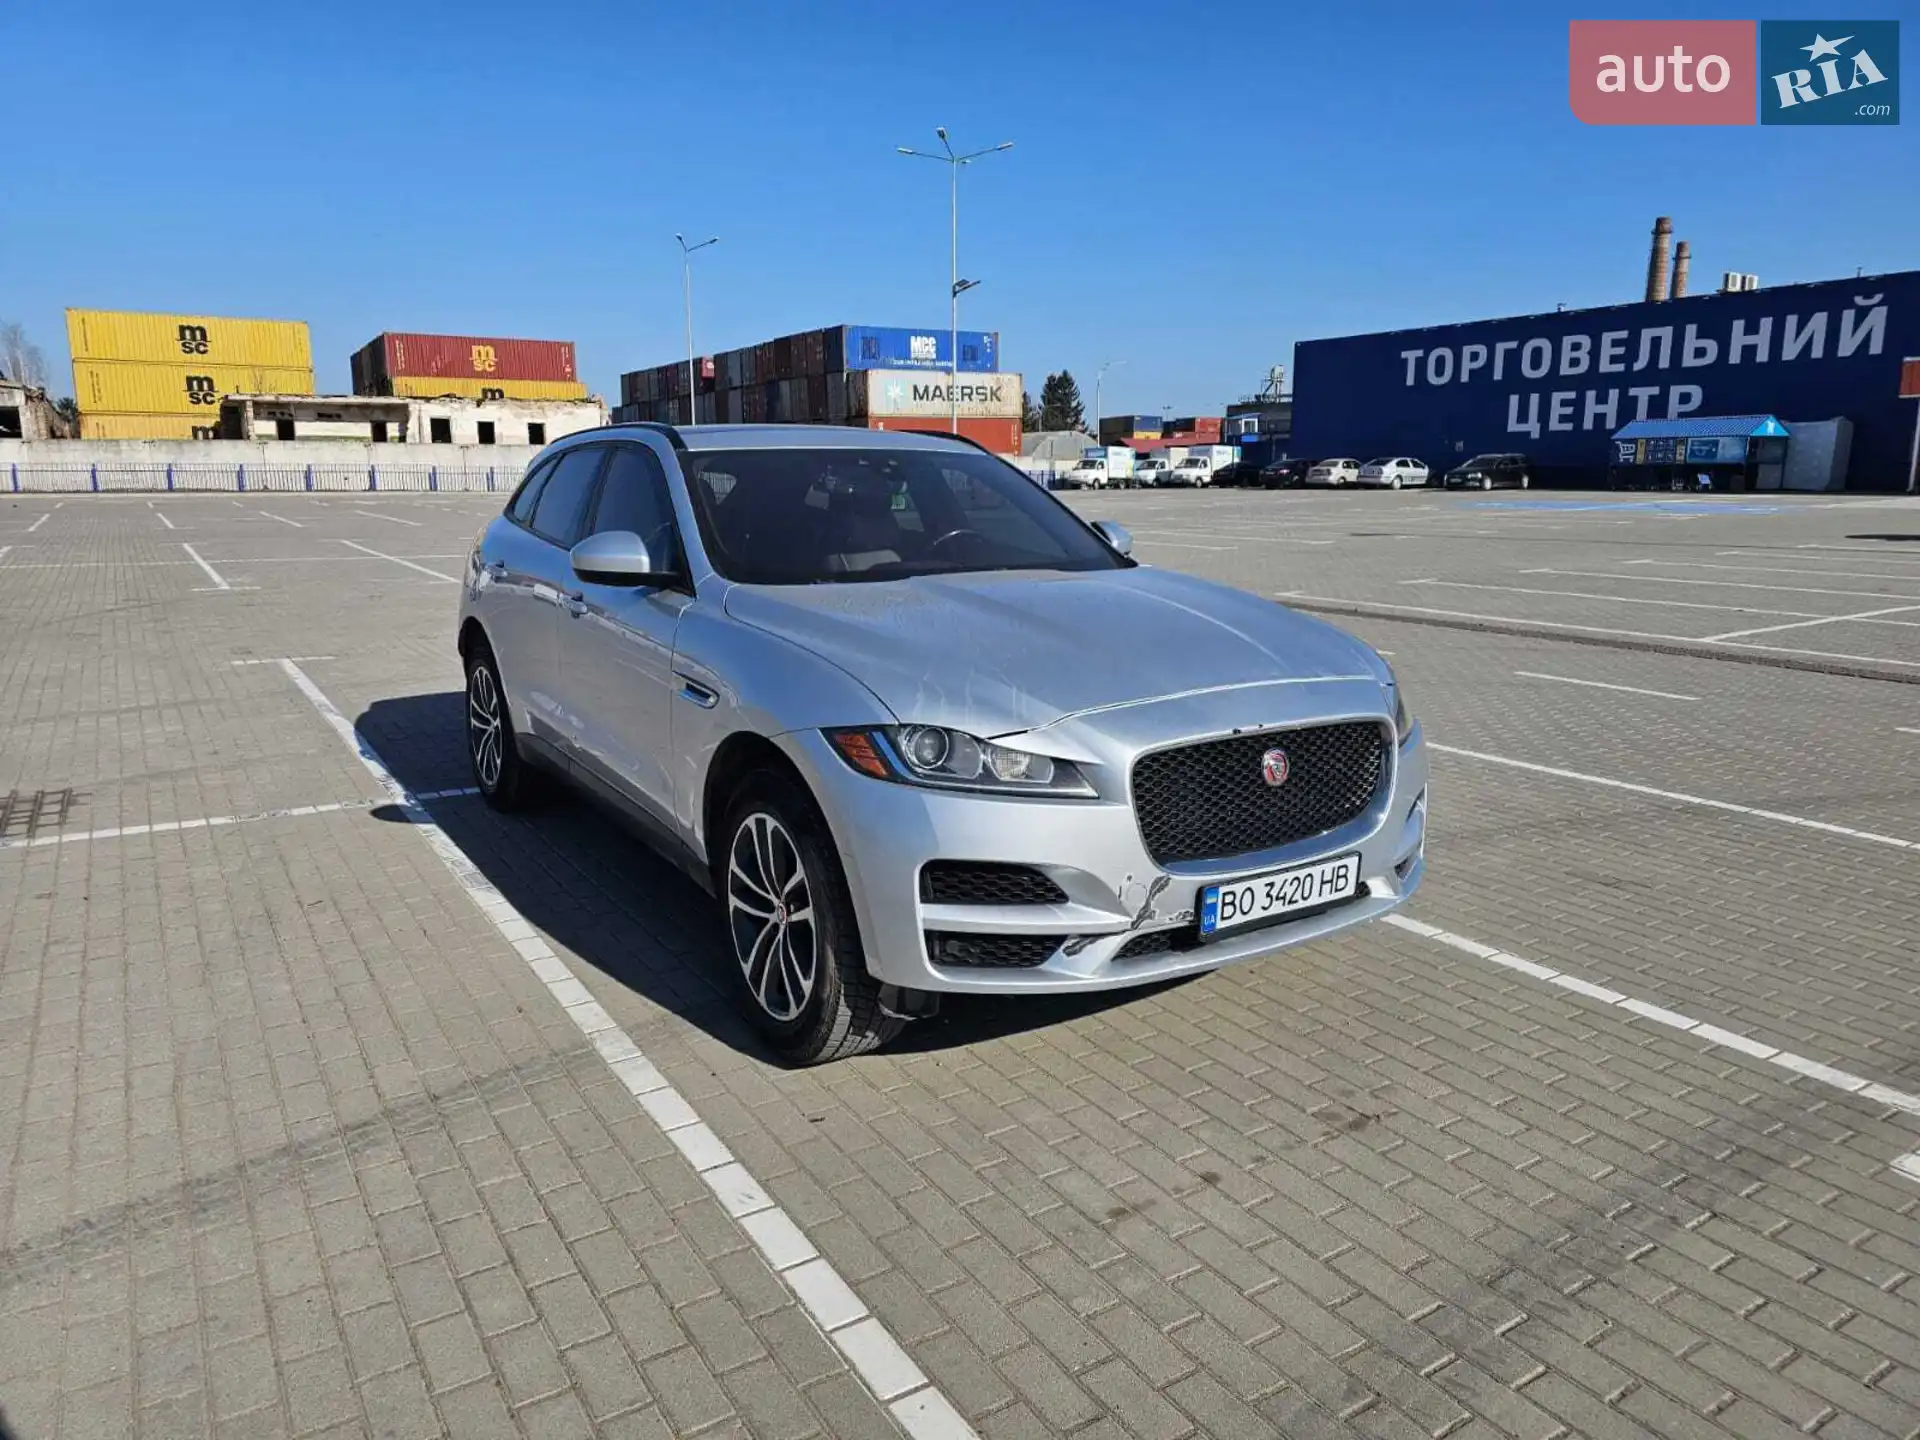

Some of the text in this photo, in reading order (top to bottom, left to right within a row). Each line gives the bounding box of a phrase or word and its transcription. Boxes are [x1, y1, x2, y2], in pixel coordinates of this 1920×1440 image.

[1400, 293, 1889, 386] ТОРГОВЕЛЬНИЙ
[912, 384, 1002, 402] MAERSK
[1506, 384, 1704, 439] ЦЕНТР
[1219, 863, 1349, 921] BO 3420 HB
